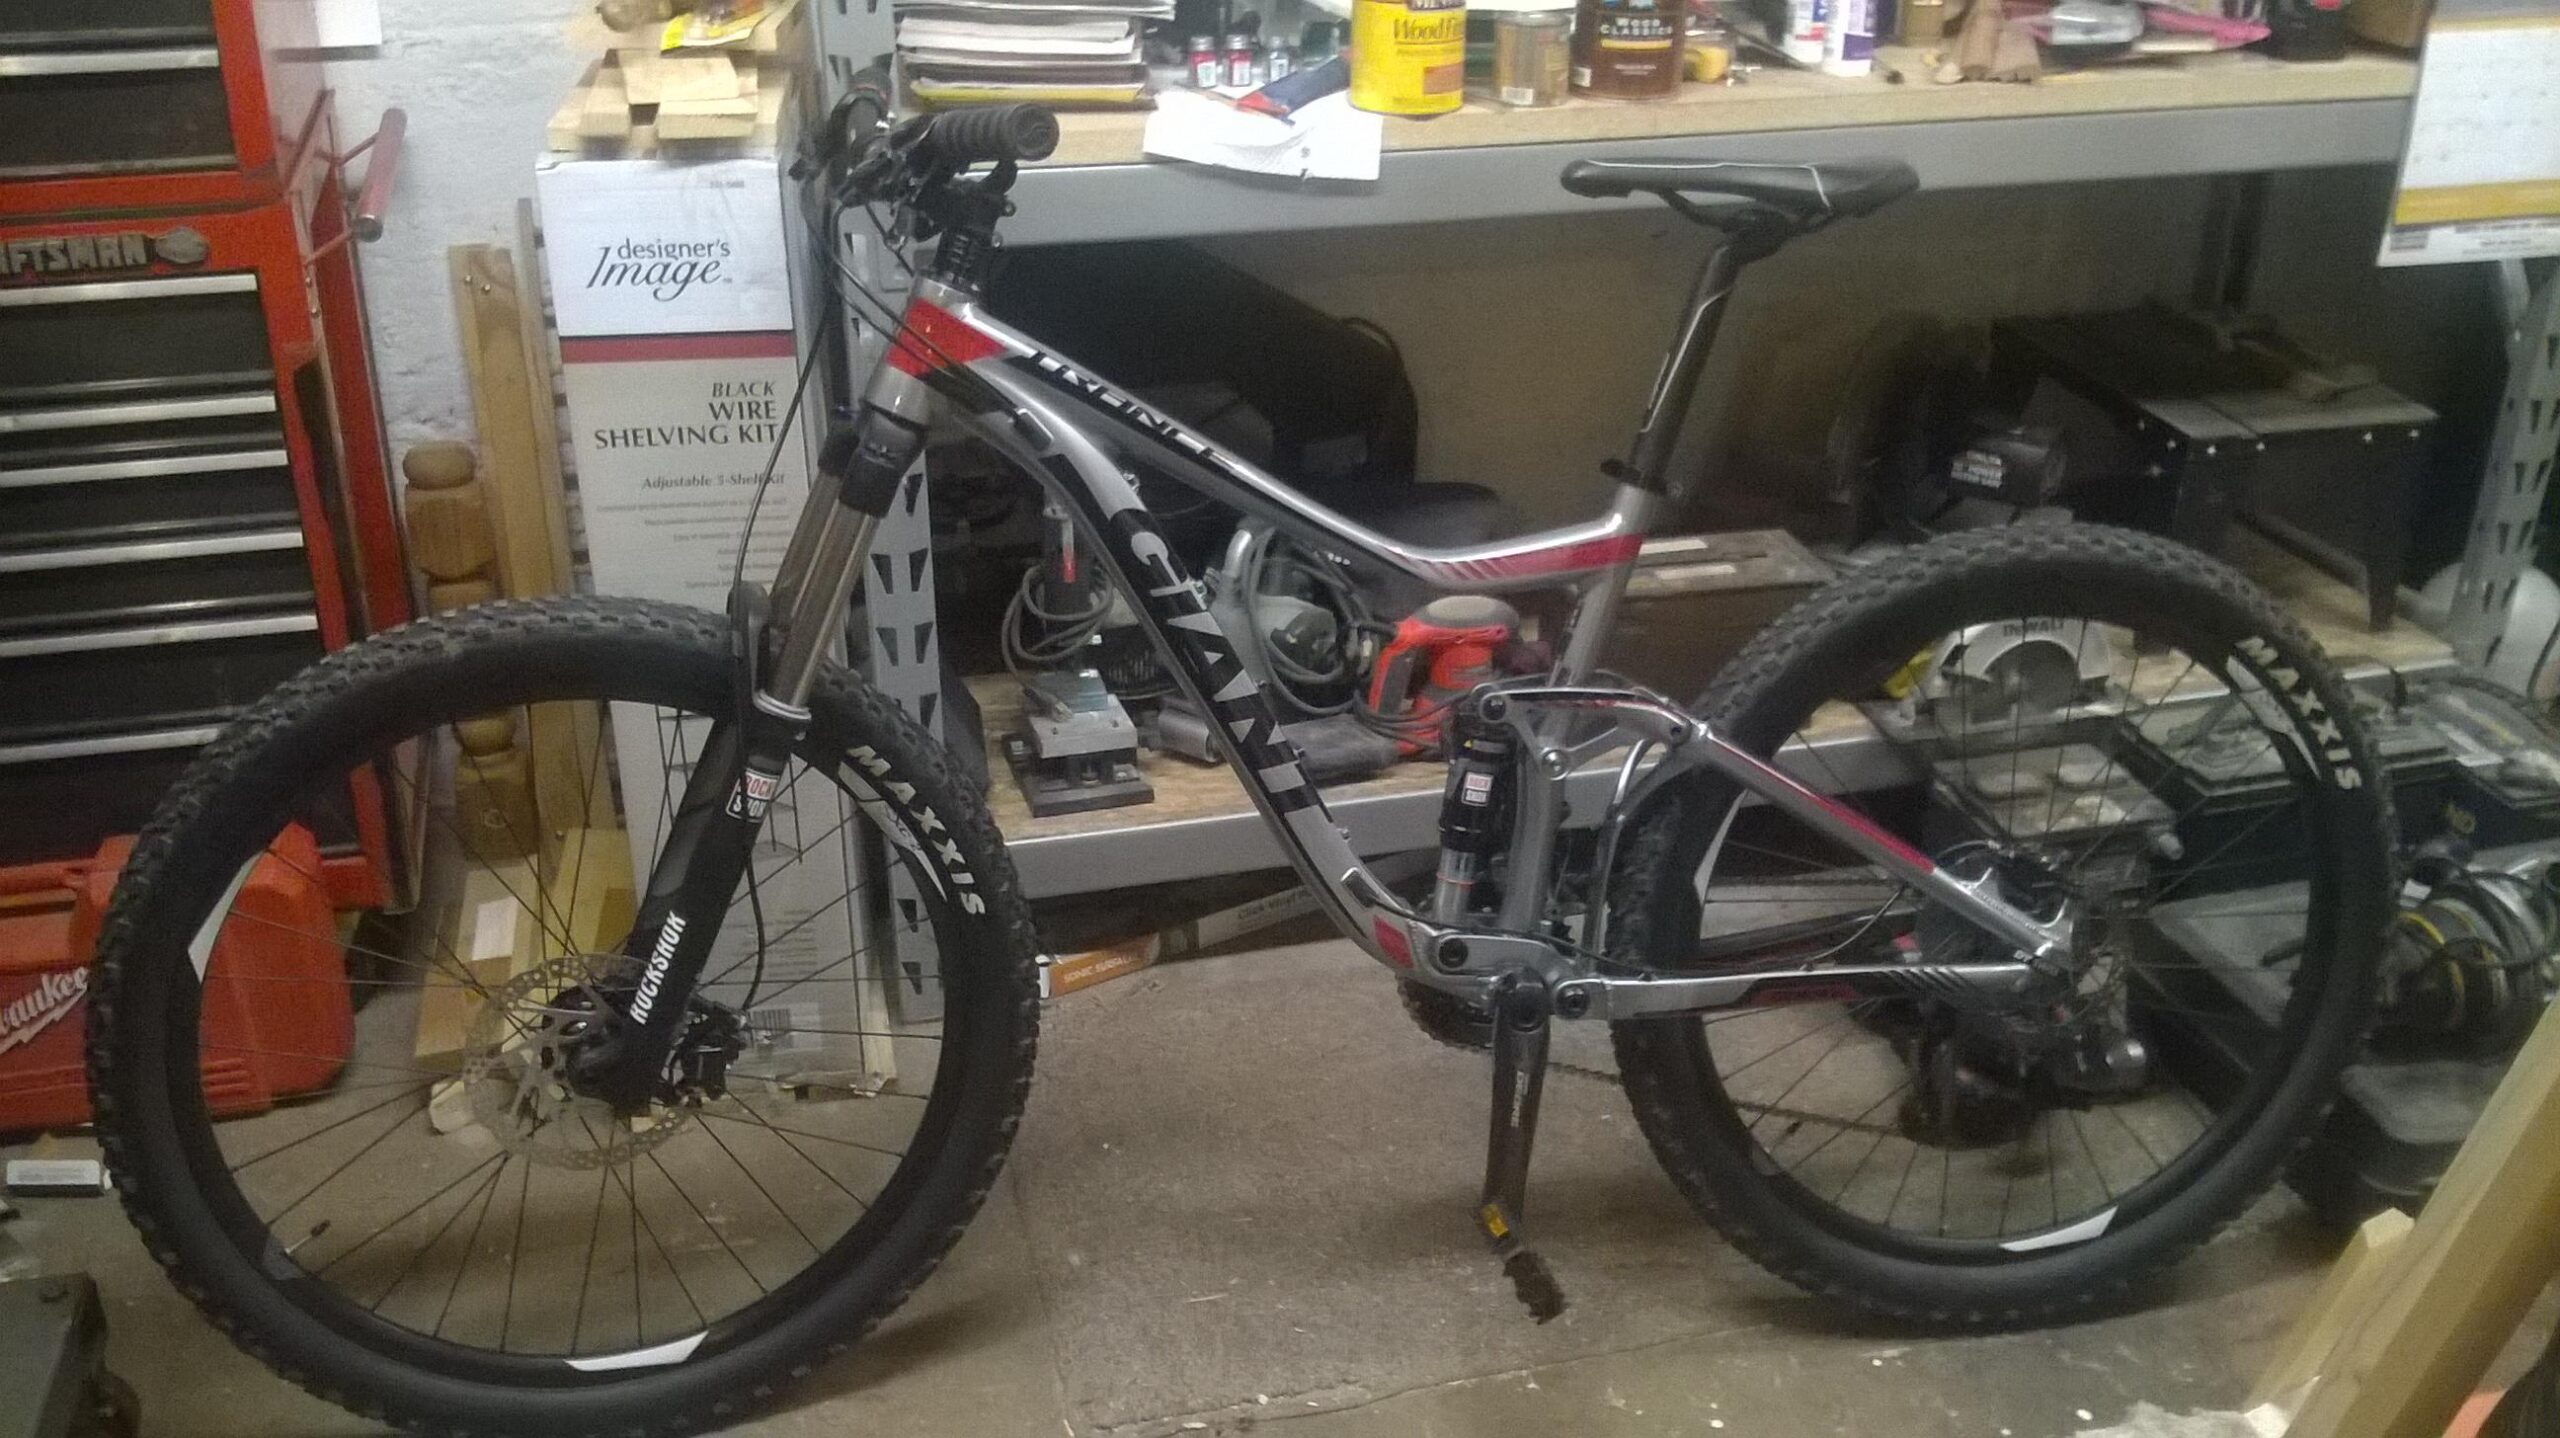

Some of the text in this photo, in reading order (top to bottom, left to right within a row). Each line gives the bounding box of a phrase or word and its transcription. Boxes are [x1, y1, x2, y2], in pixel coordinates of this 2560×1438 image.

[616, 238, 731, 261] designer's
[586, 246, 722, 302] Image
[712, 380, 776, 398] BLACK
[708, 400, 777, 421] WIRE
[594, 423, 778, 450] SHELVING KIT
[641, 474, 713, 491] Adjustable
[1108, 506, 1333, 828] GIANT
[2234, 635, 2362, 790] MAXXIS
[847, 744, 987, 915] MAXXIS
